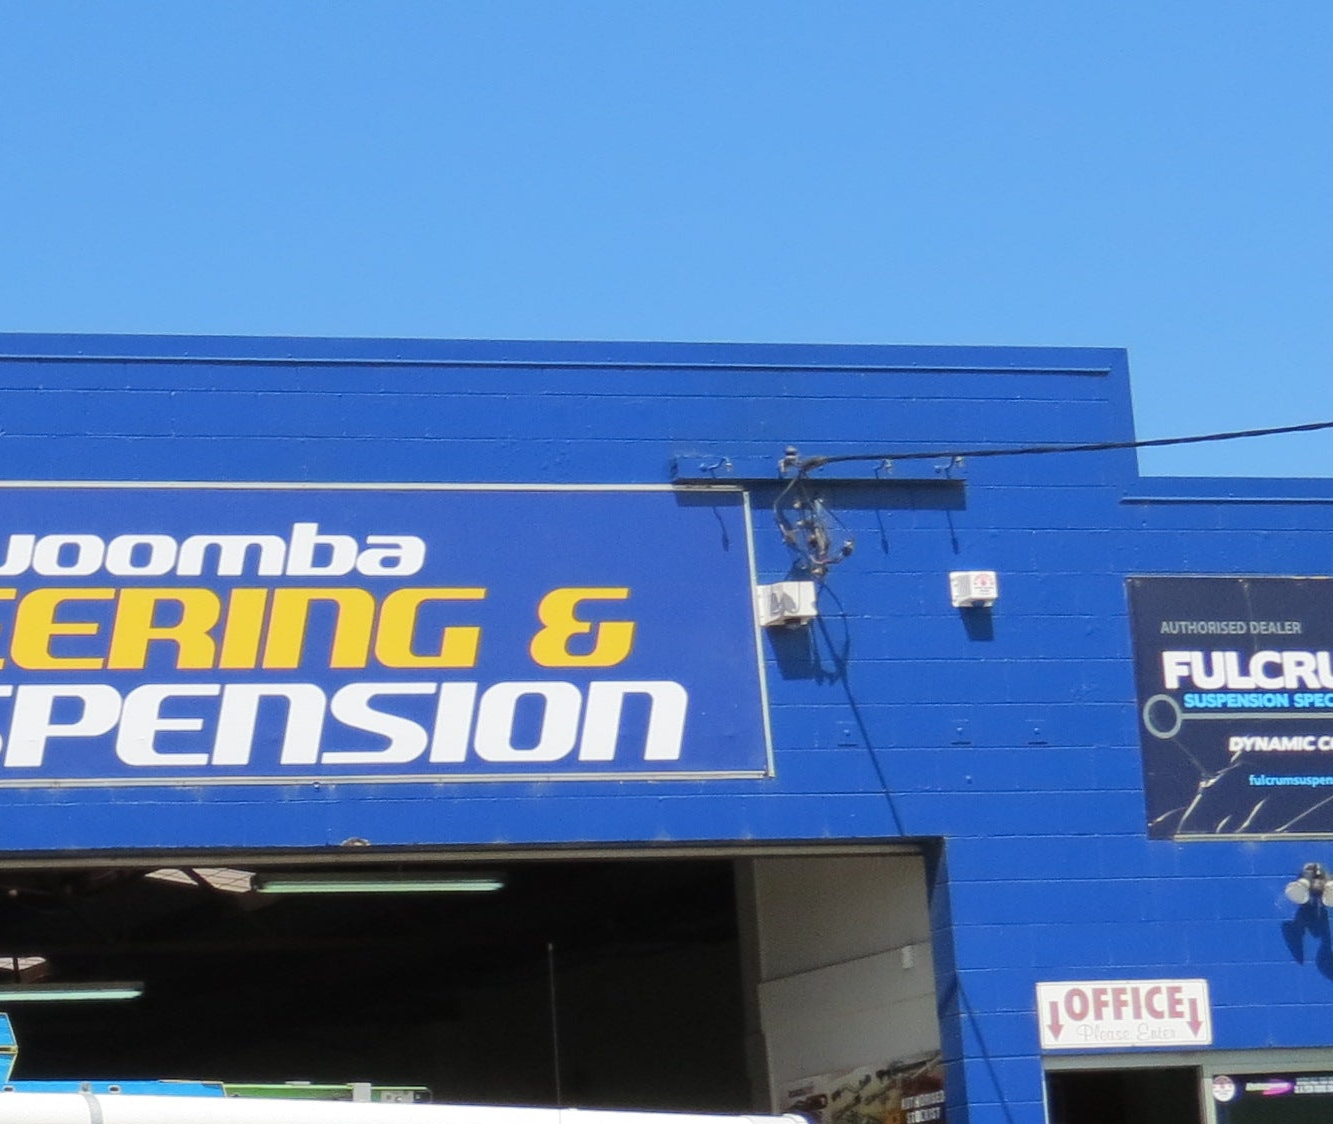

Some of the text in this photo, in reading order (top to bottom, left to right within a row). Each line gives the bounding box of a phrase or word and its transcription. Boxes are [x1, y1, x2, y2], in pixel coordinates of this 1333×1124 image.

[530, 587, 636, 668] &
[1161, 621, 1302, 635] AUTHORISED DEALER
[1184, 693, 1290, 708] SUSPENSION
[1229, 736, 1315, 751] DYNAMIC
[1064, 986, 1186, 1021] OFFICE
[1077, 1022, 1177, 1042] Please Enter
